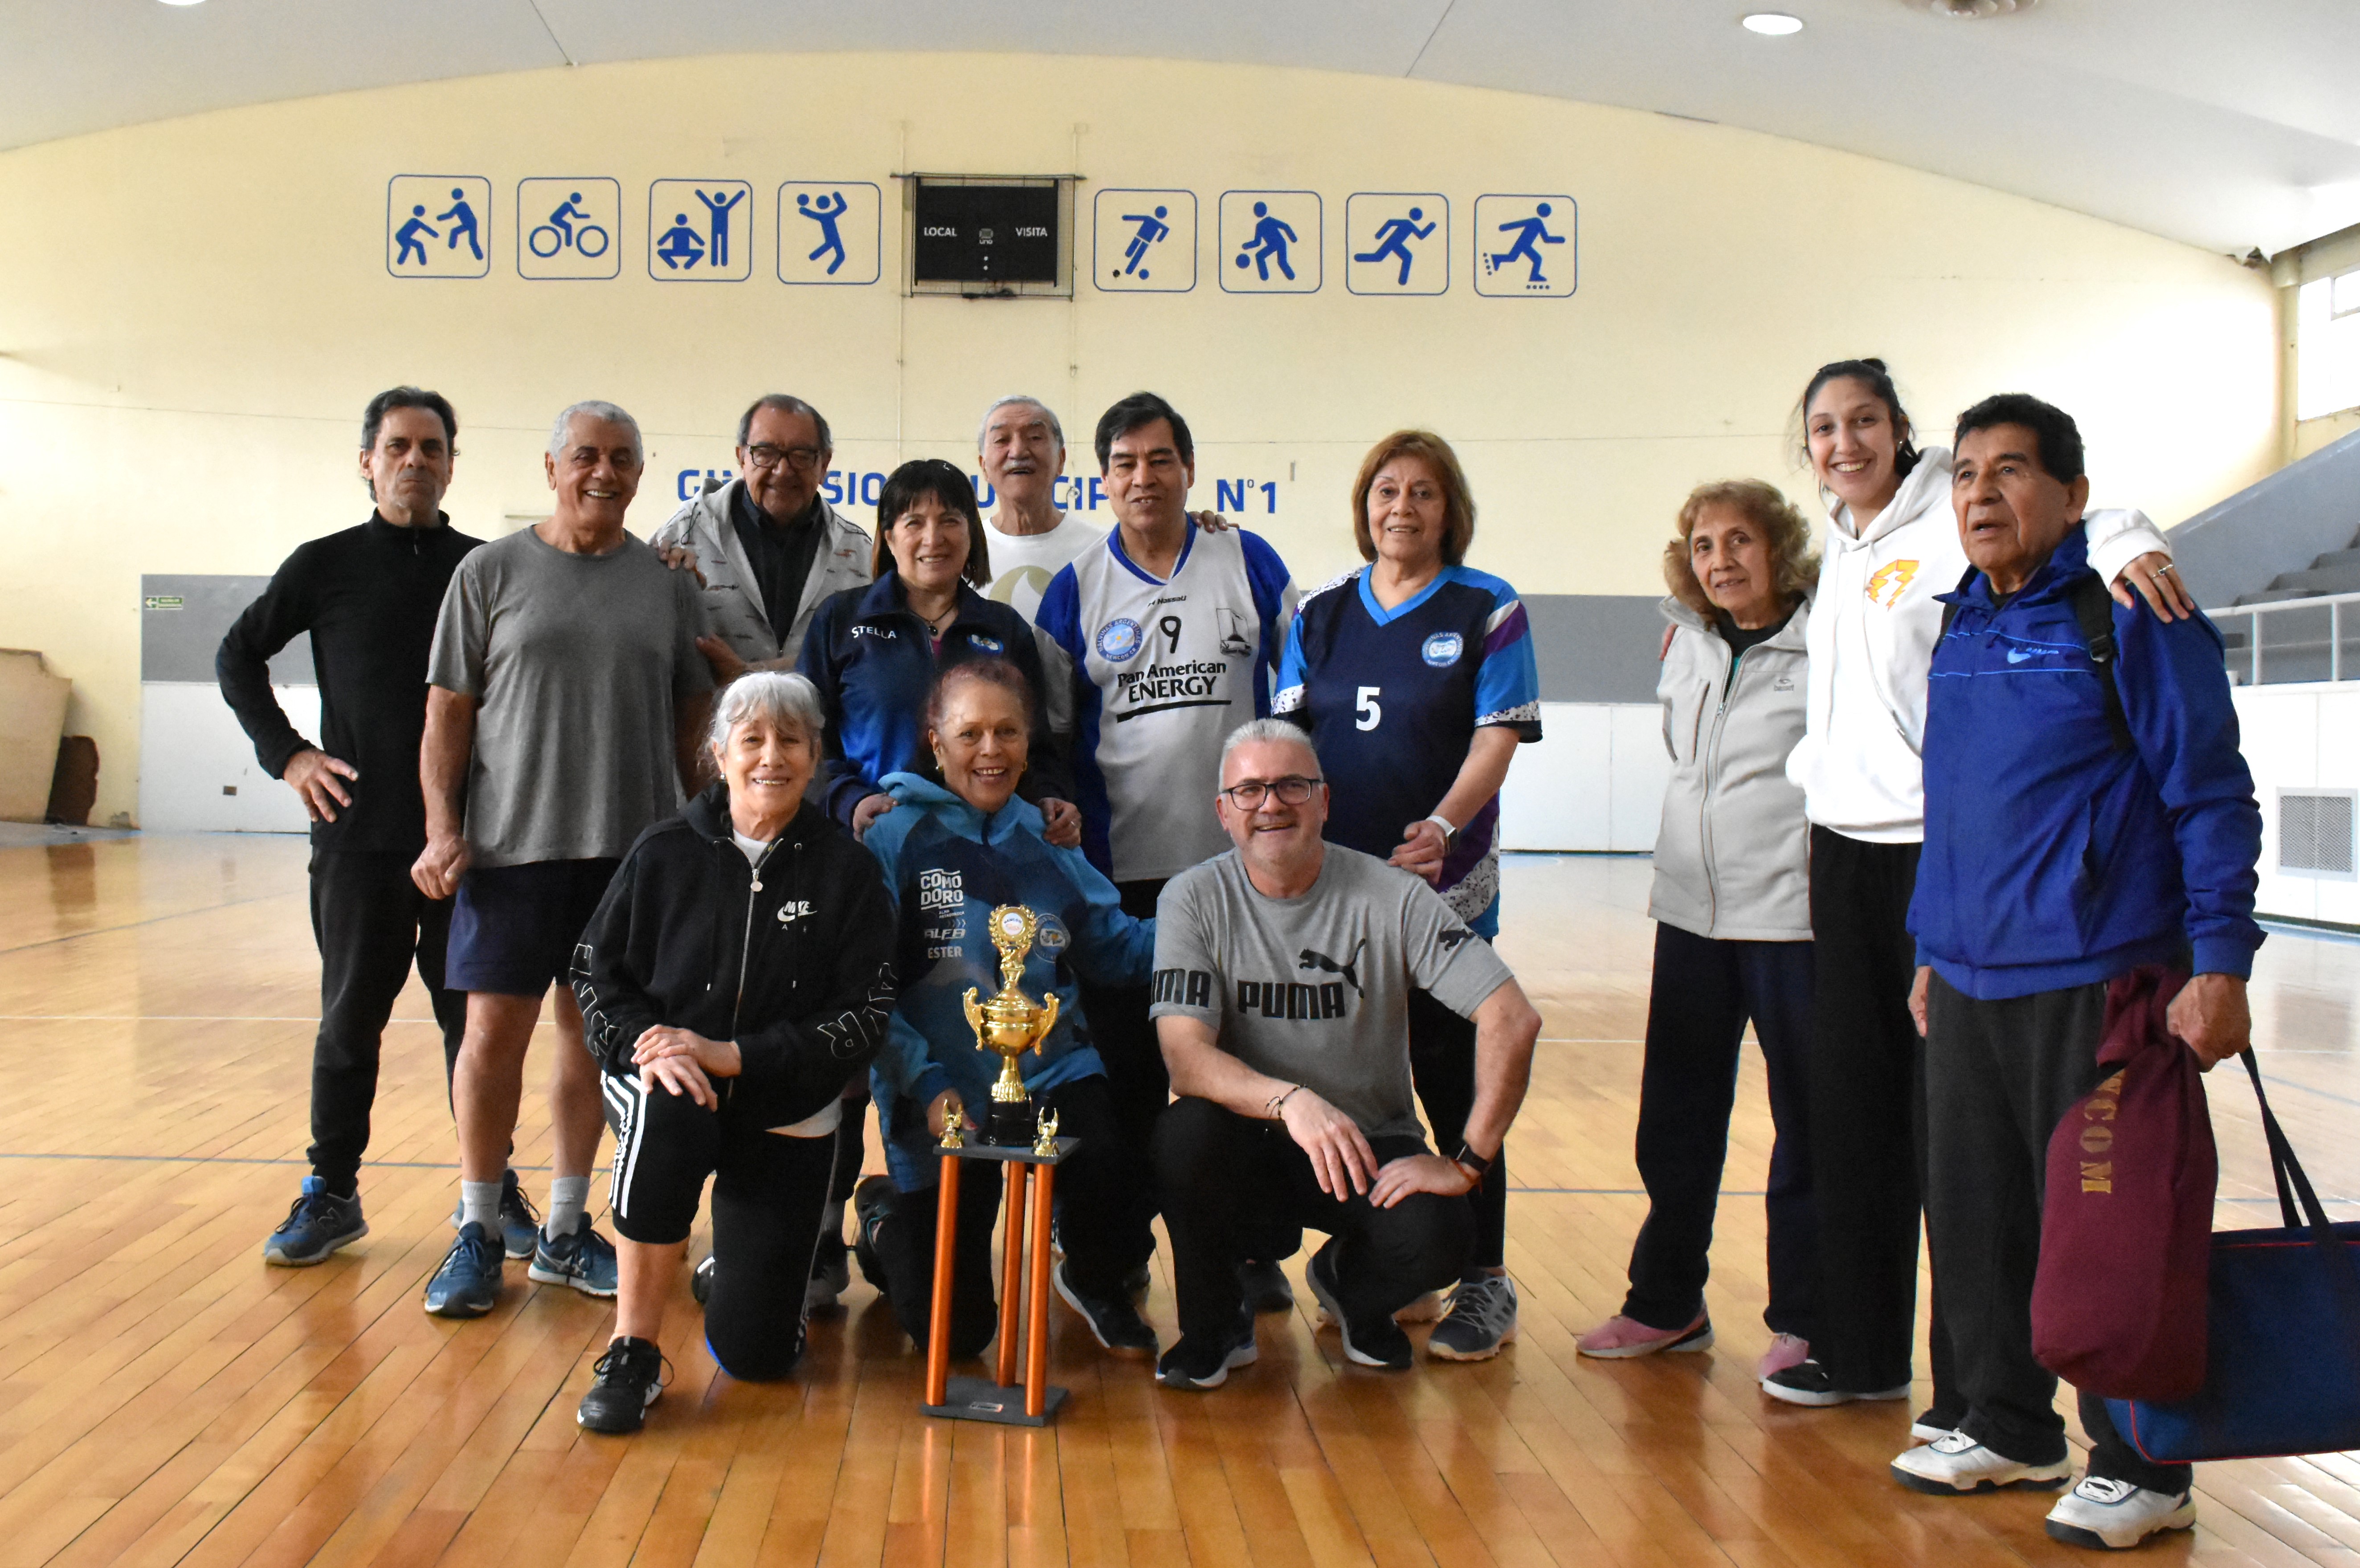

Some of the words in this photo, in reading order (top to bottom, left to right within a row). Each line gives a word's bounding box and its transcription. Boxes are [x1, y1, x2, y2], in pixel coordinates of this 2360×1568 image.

[924, 227, 957, 237] LOCAL
[1015, 227, 1048, 237] VISITA
[851, 625, 897, 639] STELLA
[1160, 615, 1182, 654] 9
[1117, 670, 1144, 688] Pan
[1147, 659, 1227, 679] American
[1128, 676, 1217, 704] ENERGY
[1356, 686, 1381, 731] 5
[920, 872, 962, 890] COMO
[921, 888, 964, 905] DORO
[927, 945, 962, 959] ESTER
[1237, 980, 1345, 1020] PUMA
